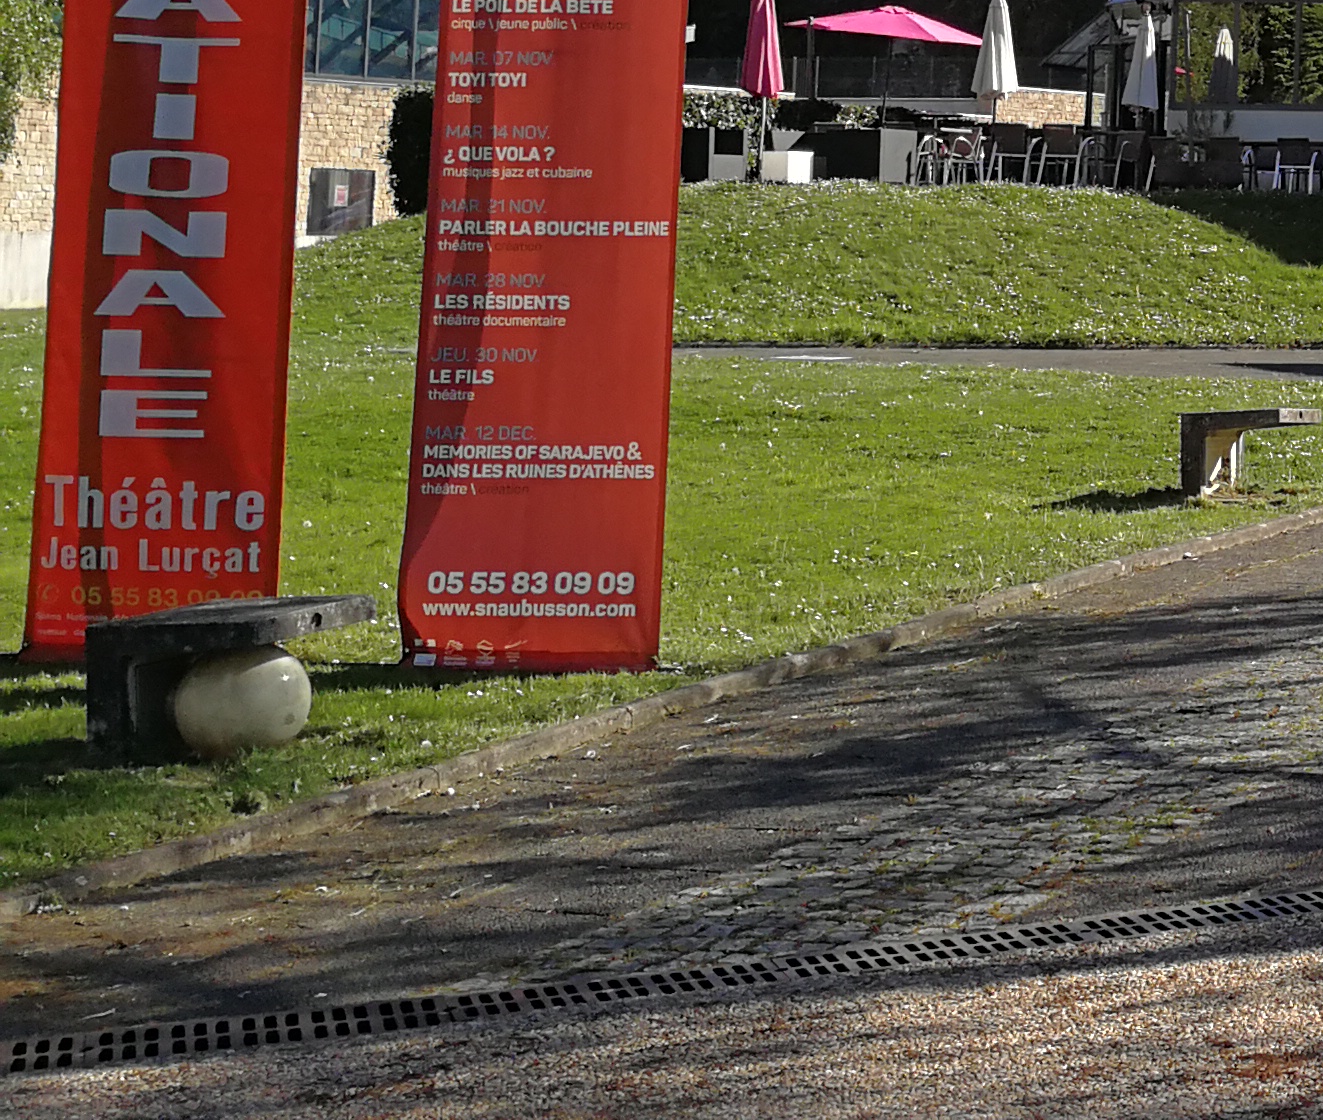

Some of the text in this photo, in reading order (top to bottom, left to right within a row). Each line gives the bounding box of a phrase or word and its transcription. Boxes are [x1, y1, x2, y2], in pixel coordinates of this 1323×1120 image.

[449, 72, 527, 88] TOYI TOYI
[447, 92, 482, 104] danse
[458, 147, 492, 162] QUE
[496, 147, 540, 162] VOLA
[443, 167, 593, 179] musiques jazz et cubaine
[439, 220, 669, 236] PARLER LA BOUCHE PLEINE
[434, 292, 570, 310] LES RÉSIDENTS
[433, 315, 566, 327] théâtre documentaire
[429, 370, 494, 384] LE FILS
[424, 445, 512, 460] MEMORIES
[515, 445, 537, 460] OF
[539, 445, 624, 460] SARAJEVO
[45, 475, 265, 531] Théâtre
[41, 537, 261, 578] Jean Lurçat
[428, 571, 635, 595] 05 55 83 09 09
[70, 587, 102, 606] 05
[110, 587, 140, 607] 55
[147, 587, 179, 608] 83
[423, 599, 635, 617] www.snaubusson.com
